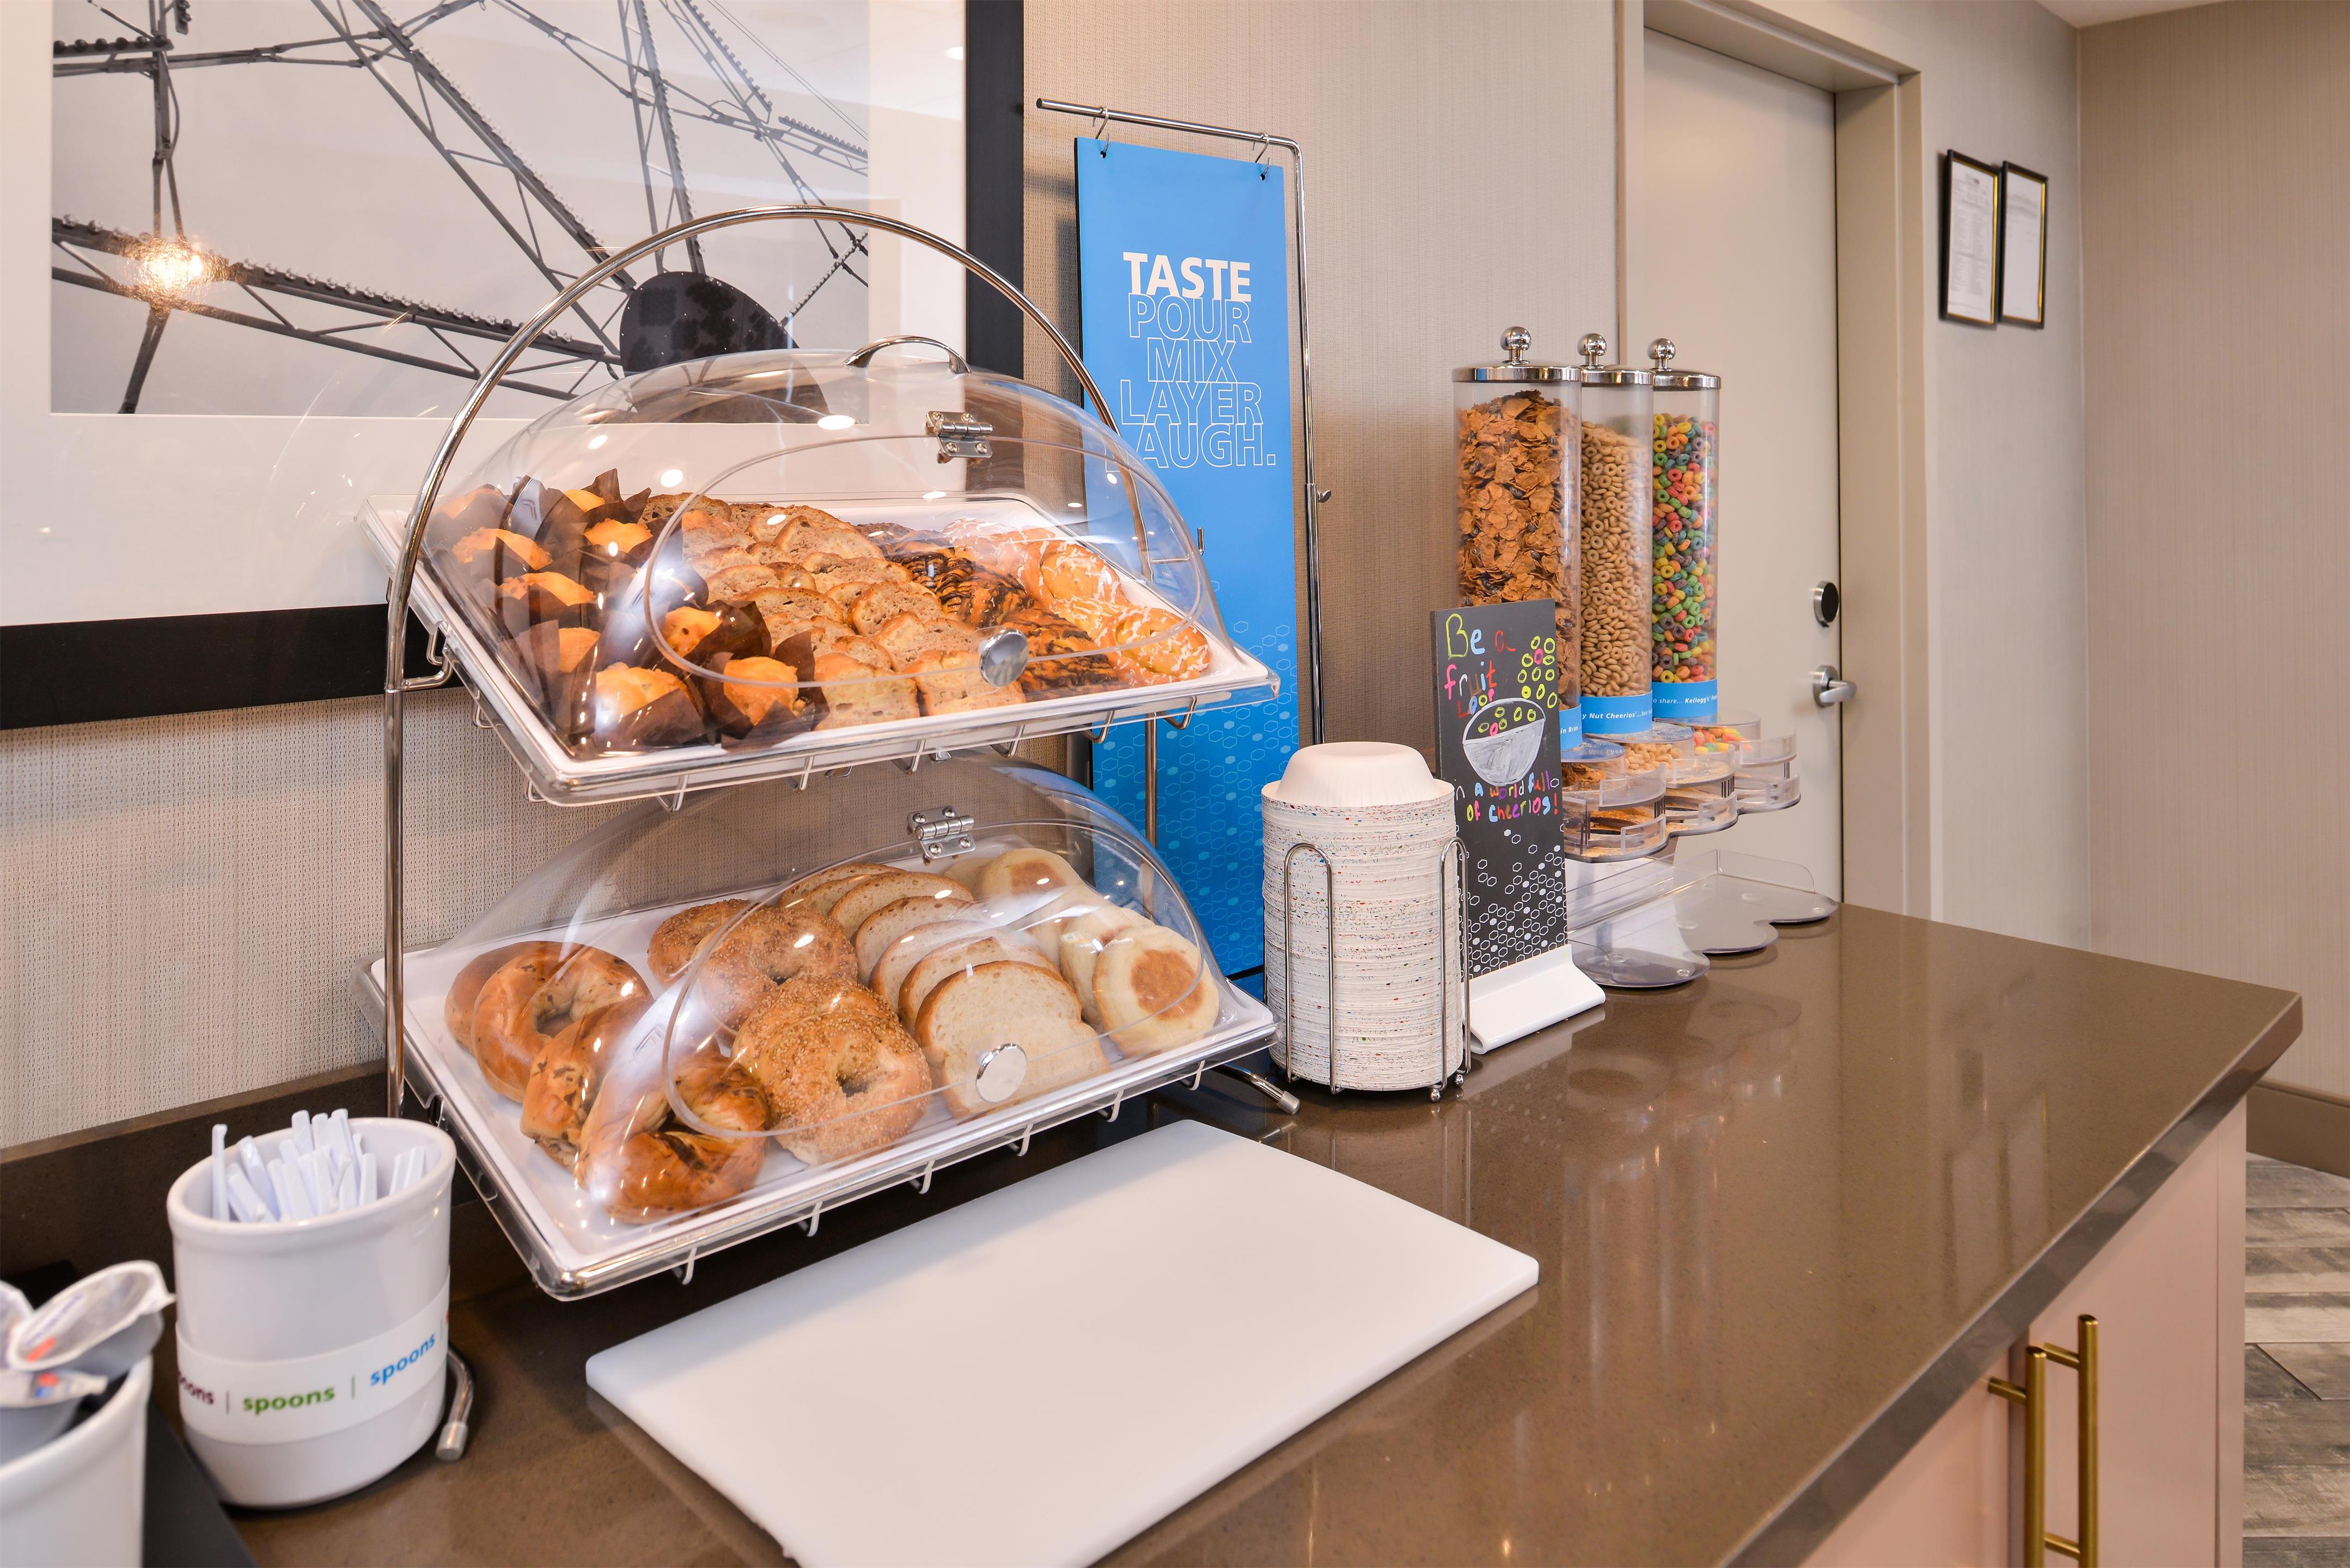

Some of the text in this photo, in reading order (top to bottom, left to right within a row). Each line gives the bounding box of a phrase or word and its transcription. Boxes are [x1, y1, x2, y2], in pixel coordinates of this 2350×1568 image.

[1122, 251, 1252, 302] TASTE
[1128, 292, 1252, 342] POUR
[1147, 337, 1237, 383] MIX
[1120, 379, 1263, 425] LAYER
[1445, 613, 1517, 660] Be a
[1444, 659, 1498, 700] fruit
[1466, 800, 1481, 822] of
[1490, 779, 1524, 800] world
[243, 1386, 336, 1416] spoons
[370, 1333, 436, 1386] spoons
